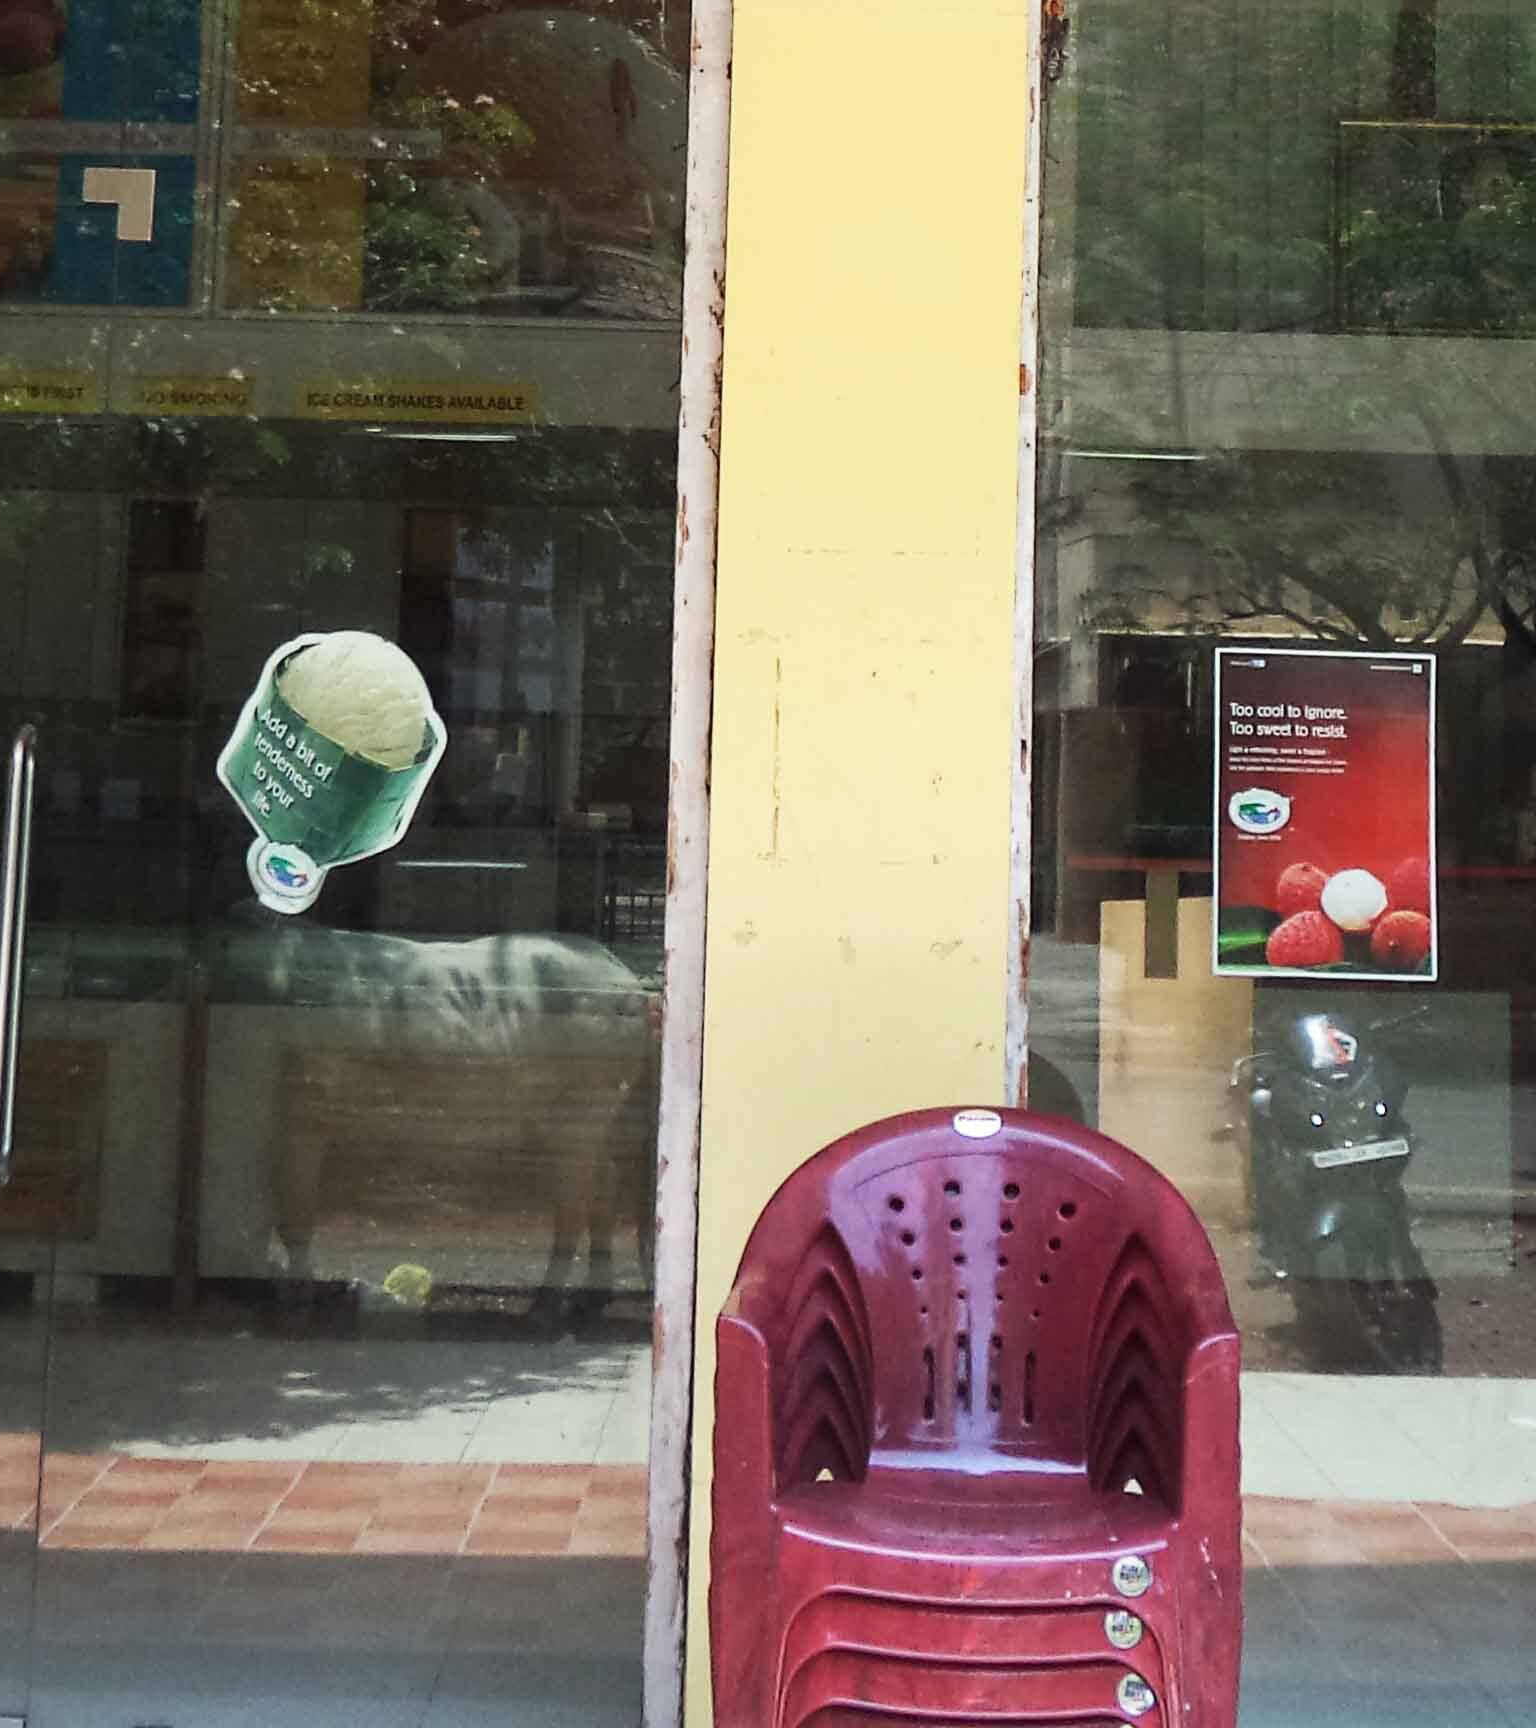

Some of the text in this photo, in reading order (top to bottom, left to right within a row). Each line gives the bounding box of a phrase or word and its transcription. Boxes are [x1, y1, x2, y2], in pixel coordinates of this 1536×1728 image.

[1229, 703, 1254, 718] Too
[1257, 703, 1284, 719] cool
[1287, 705, 1301, 718] to
[1229, 721, 1349, 739] Too sweet to resist.
[254, 732, 314, 798] tenderness
[261, 708, 333, 783] Add a bit of
[253, 761, 295, 809] to your
